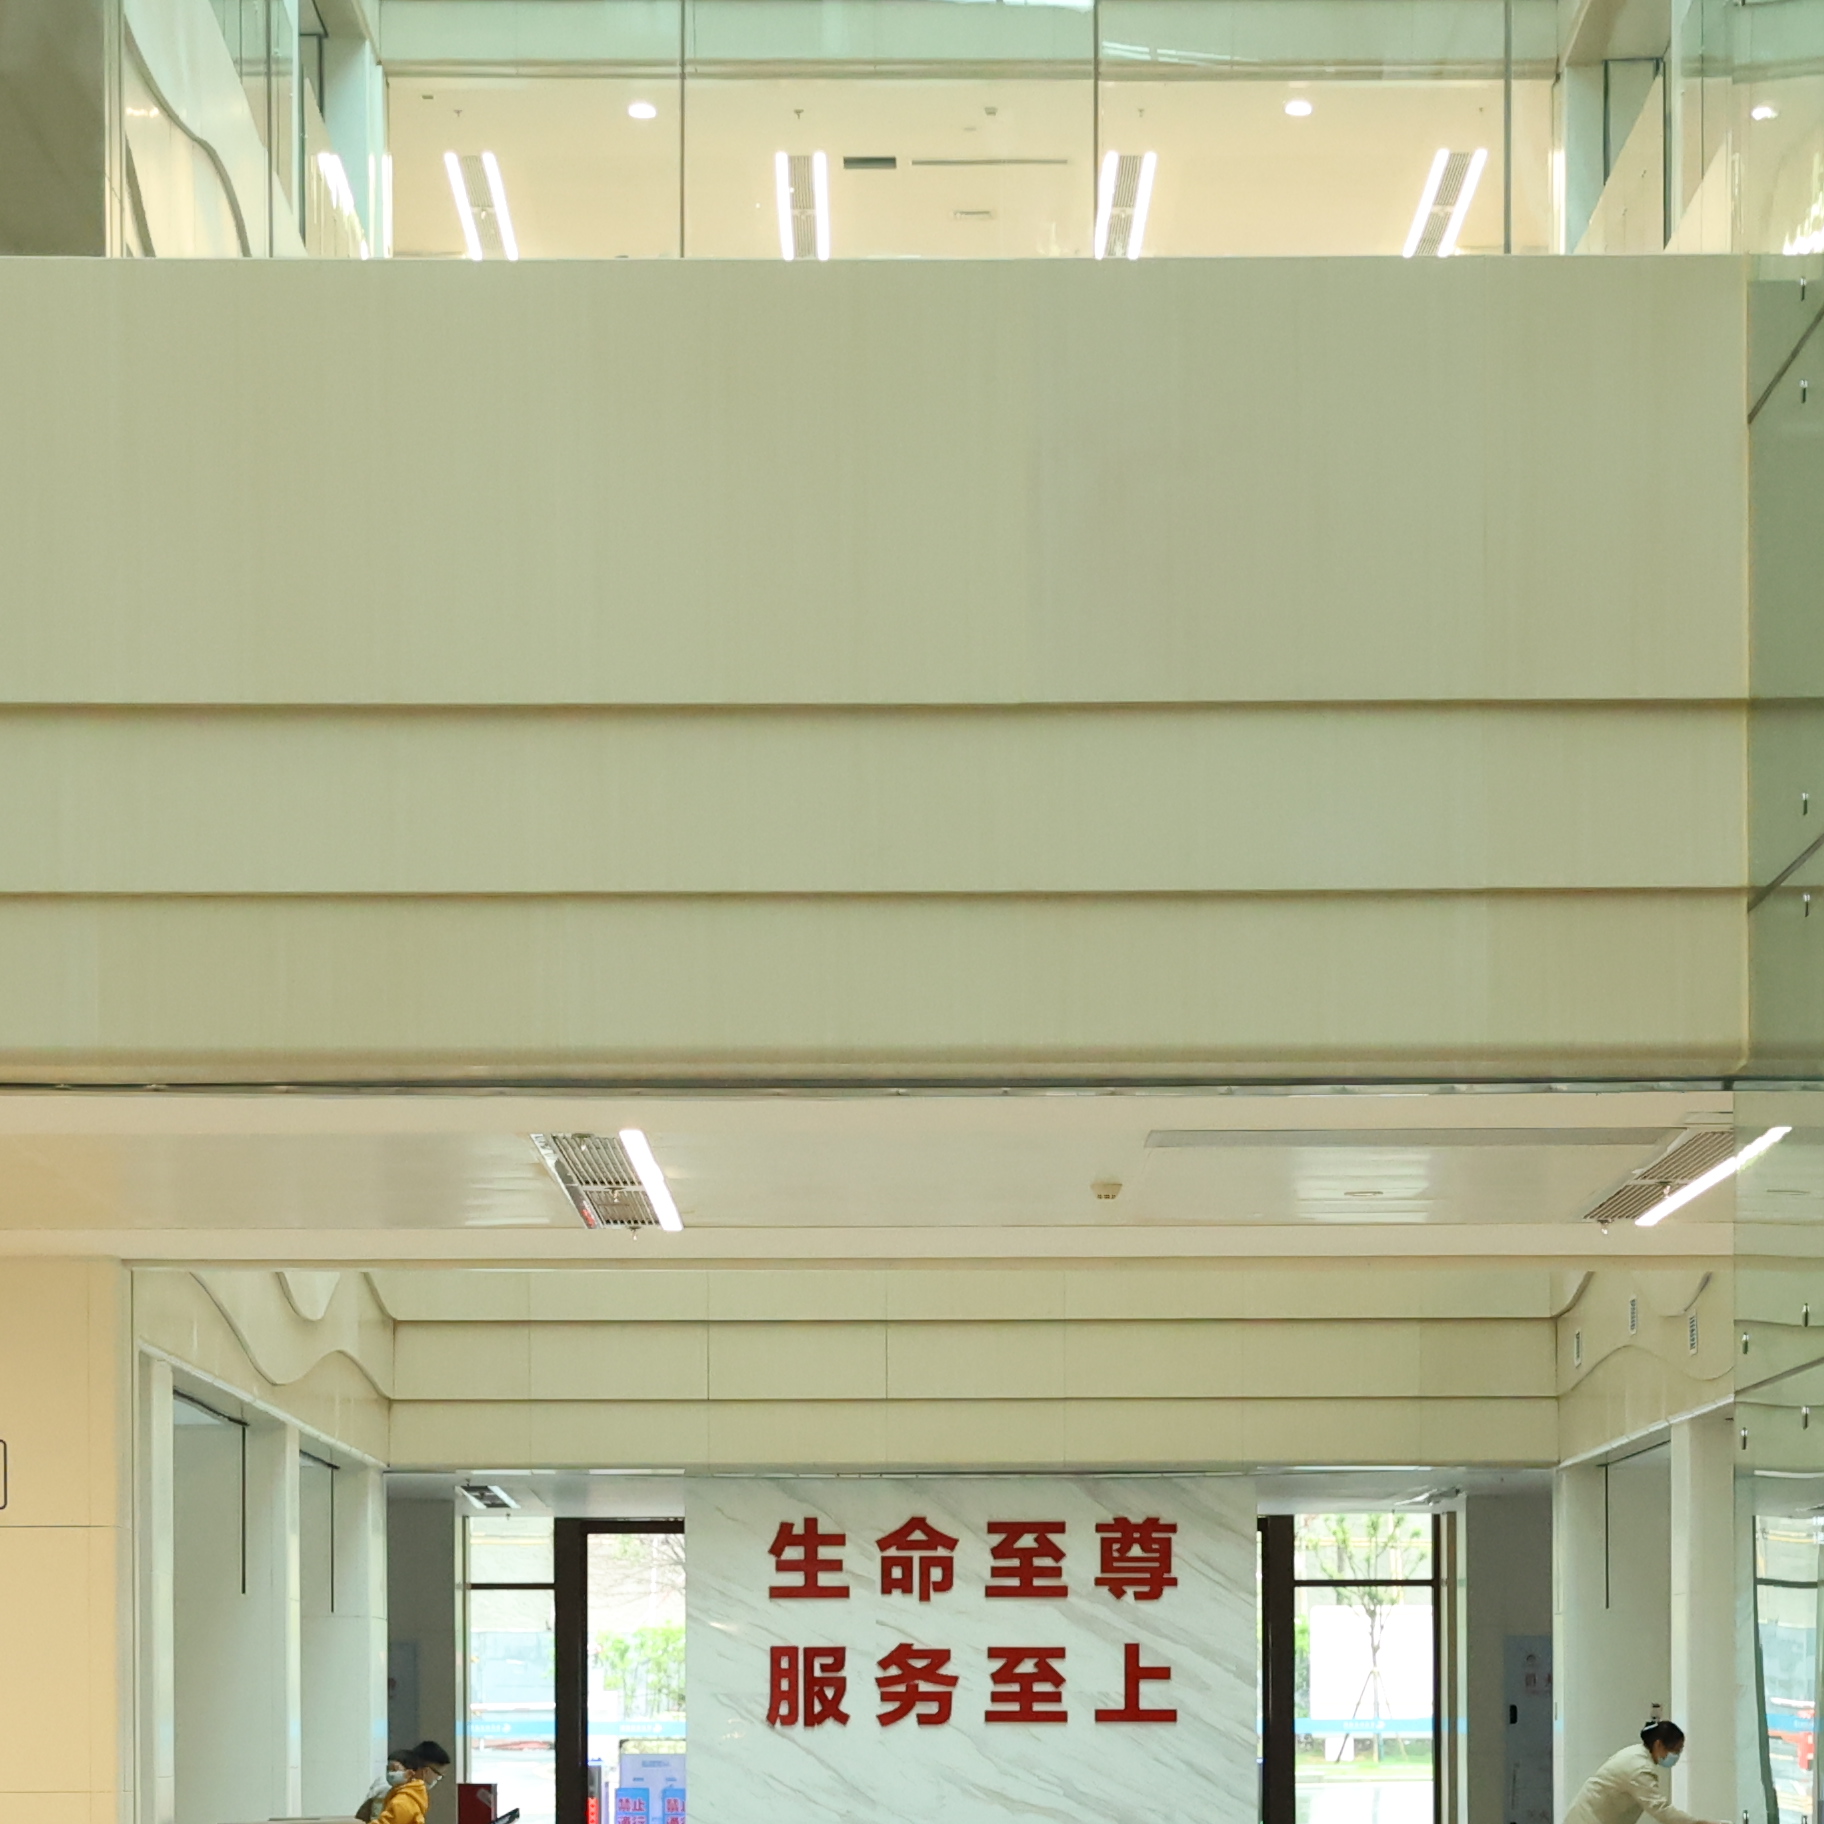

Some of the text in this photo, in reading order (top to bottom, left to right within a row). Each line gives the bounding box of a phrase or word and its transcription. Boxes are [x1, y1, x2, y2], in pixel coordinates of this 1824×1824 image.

[768, 1516, 1178, 1602] 生命至尊
[766, 1643, 1178, 1728] 服务至上
